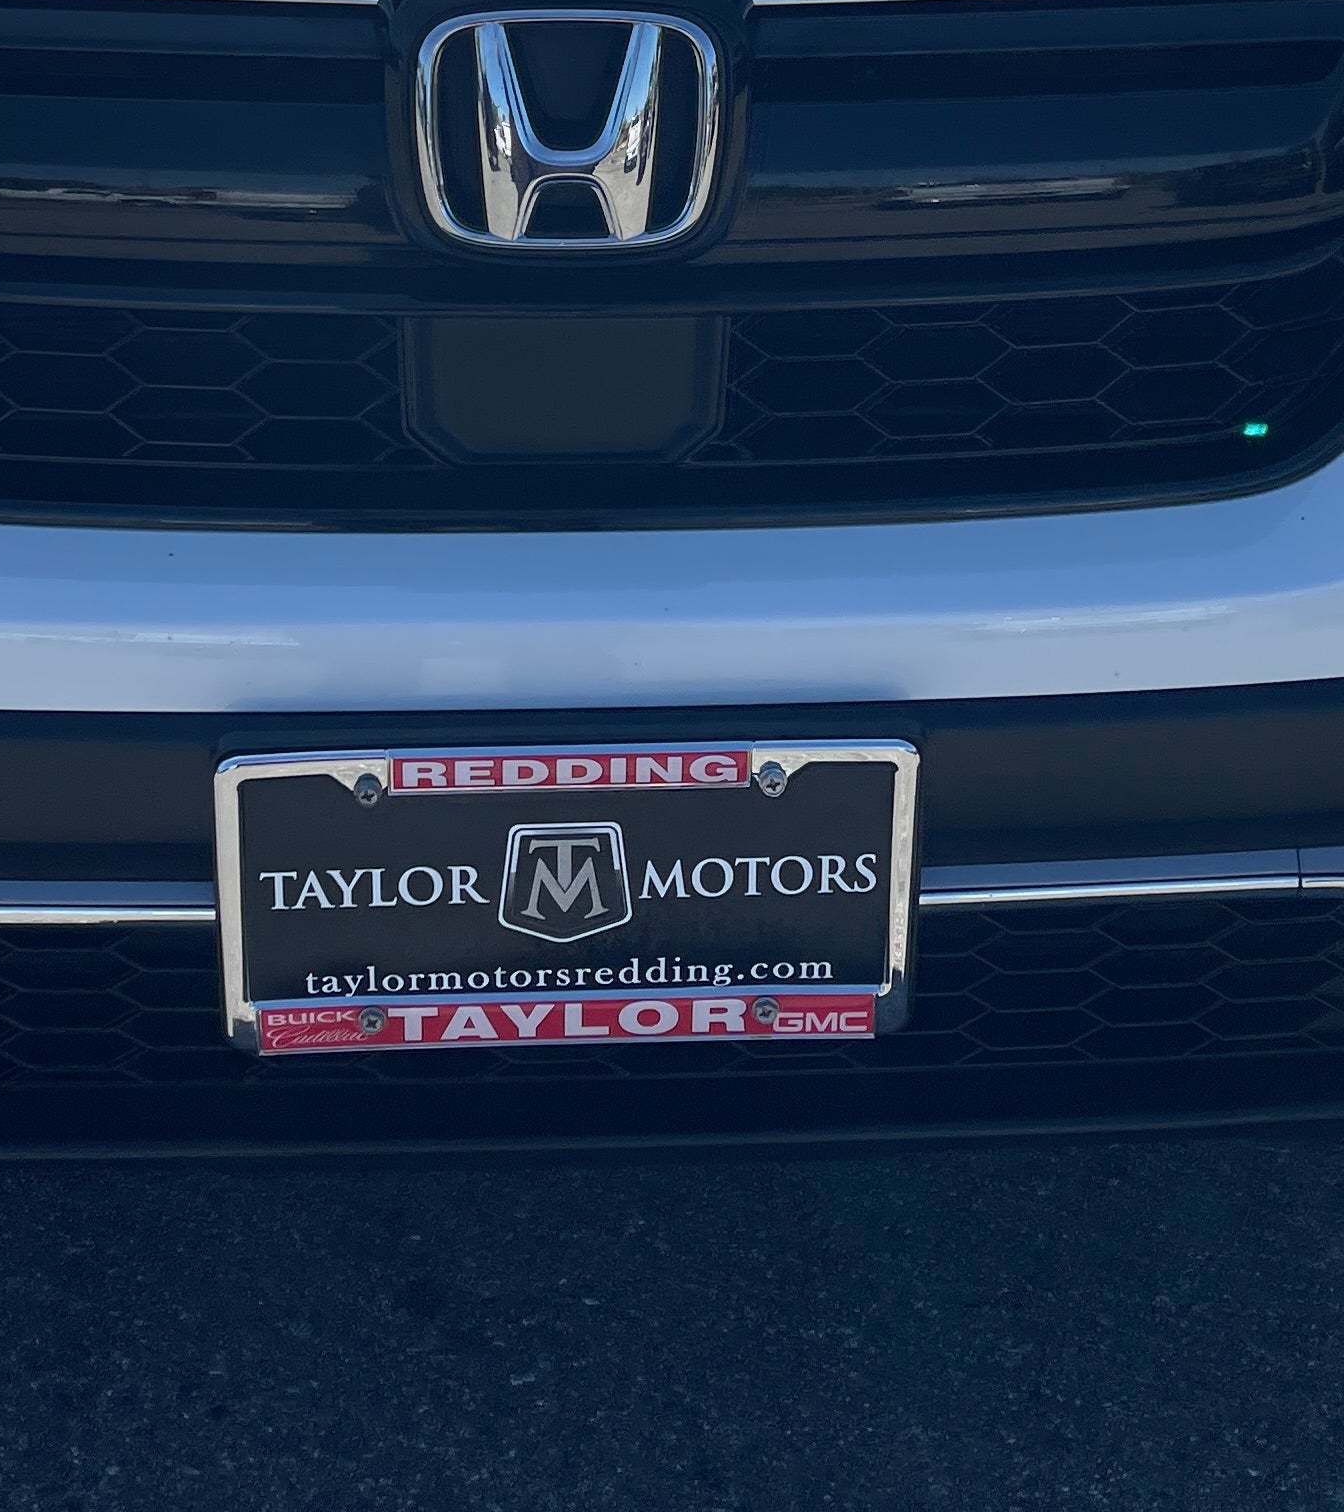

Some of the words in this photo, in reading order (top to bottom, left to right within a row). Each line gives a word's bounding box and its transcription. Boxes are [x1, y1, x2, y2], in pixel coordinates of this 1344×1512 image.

[402, 755, 739, 787] REDDING
[259, 865, 490, 910] TAYLOR
[638, 853, 877, 899] MOTORS
[305, 956, 834, 996] taylormotorsredding.com
[267, 1010, 356, 1026] BUICK
[387, 999, 746, 1041] TAYLOR
[773, 1011, 868, 1033] GMC
